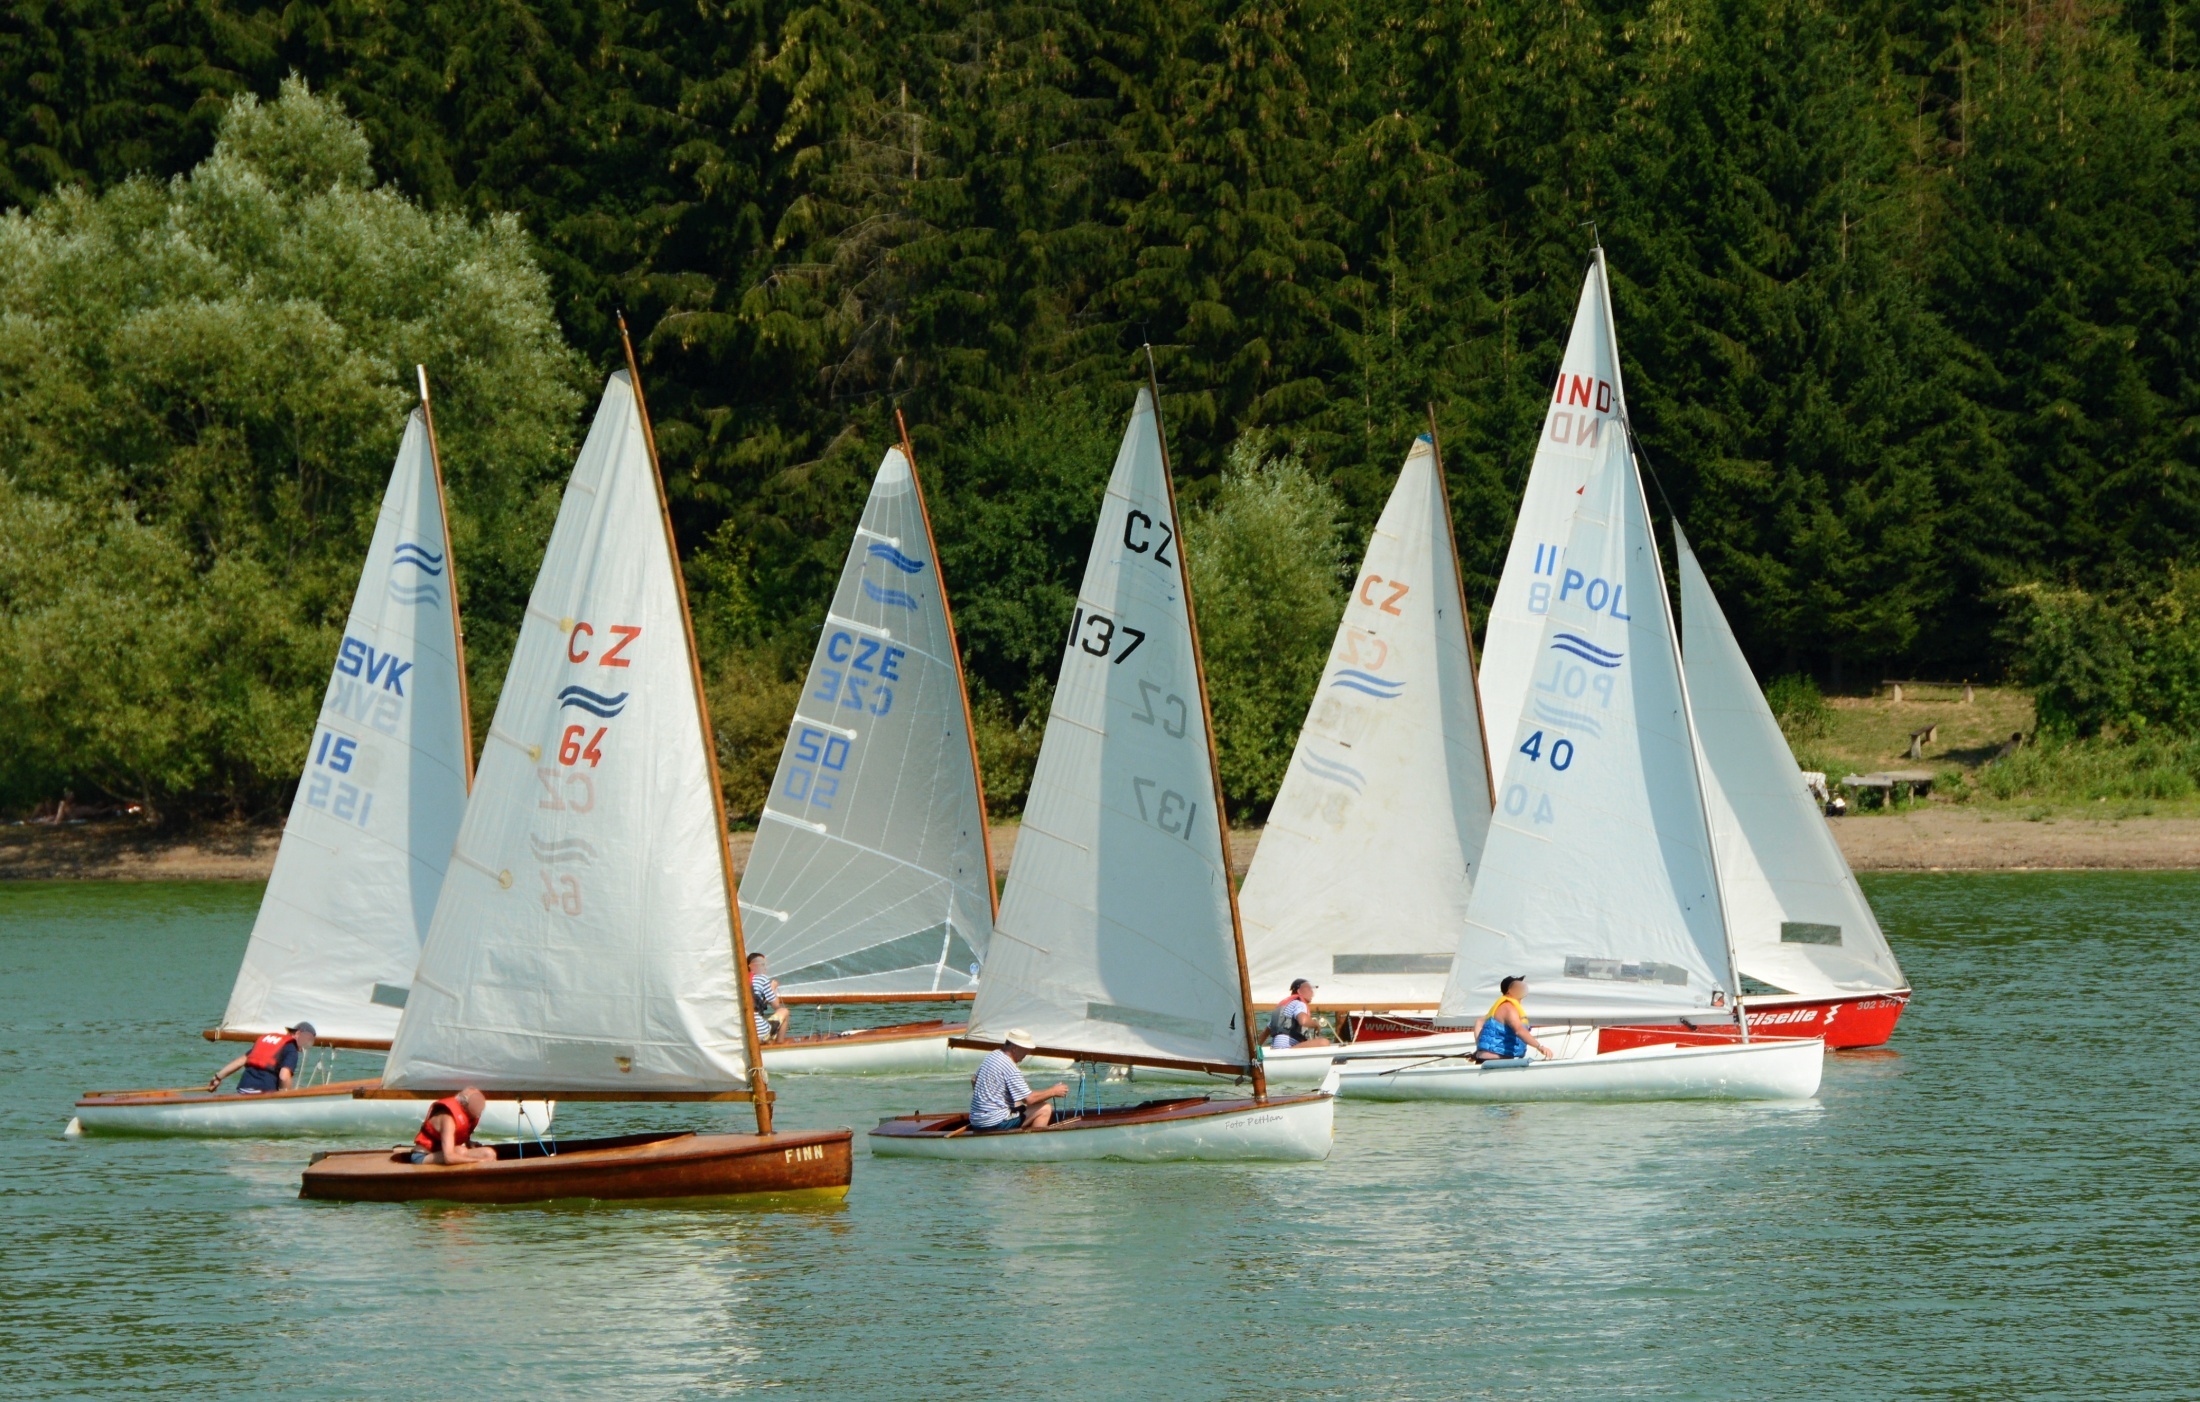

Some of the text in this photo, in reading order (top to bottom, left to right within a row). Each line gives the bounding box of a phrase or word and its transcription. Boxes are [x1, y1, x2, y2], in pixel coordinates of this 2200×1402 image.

[1555, 373, 1612, 414] IND
[1123, 509, 1173, 569] CZ
[1359, 574, 1410, 617] CZ
[1559, 568, 1632, 622] POL
[567, 621, 642, 668] CZ
[827, 631, 905, 682] CZE
[1068, 607, 1146, 665] 137
[336, 636, 414, 698] SVK
[315, 732, 358, 774] 15
[558, 724, 608, 768] 64
[795, 728, 851, 772] 50
[1519, 730, 1574, 772] 40
[1745, 1009, 1819, 1026] Giselle
[1856, 999, 1898, 1011] 302 374
[1225, 1119, 1245, 1130] Foto
[784, 1144, 824, 1164] FINN
